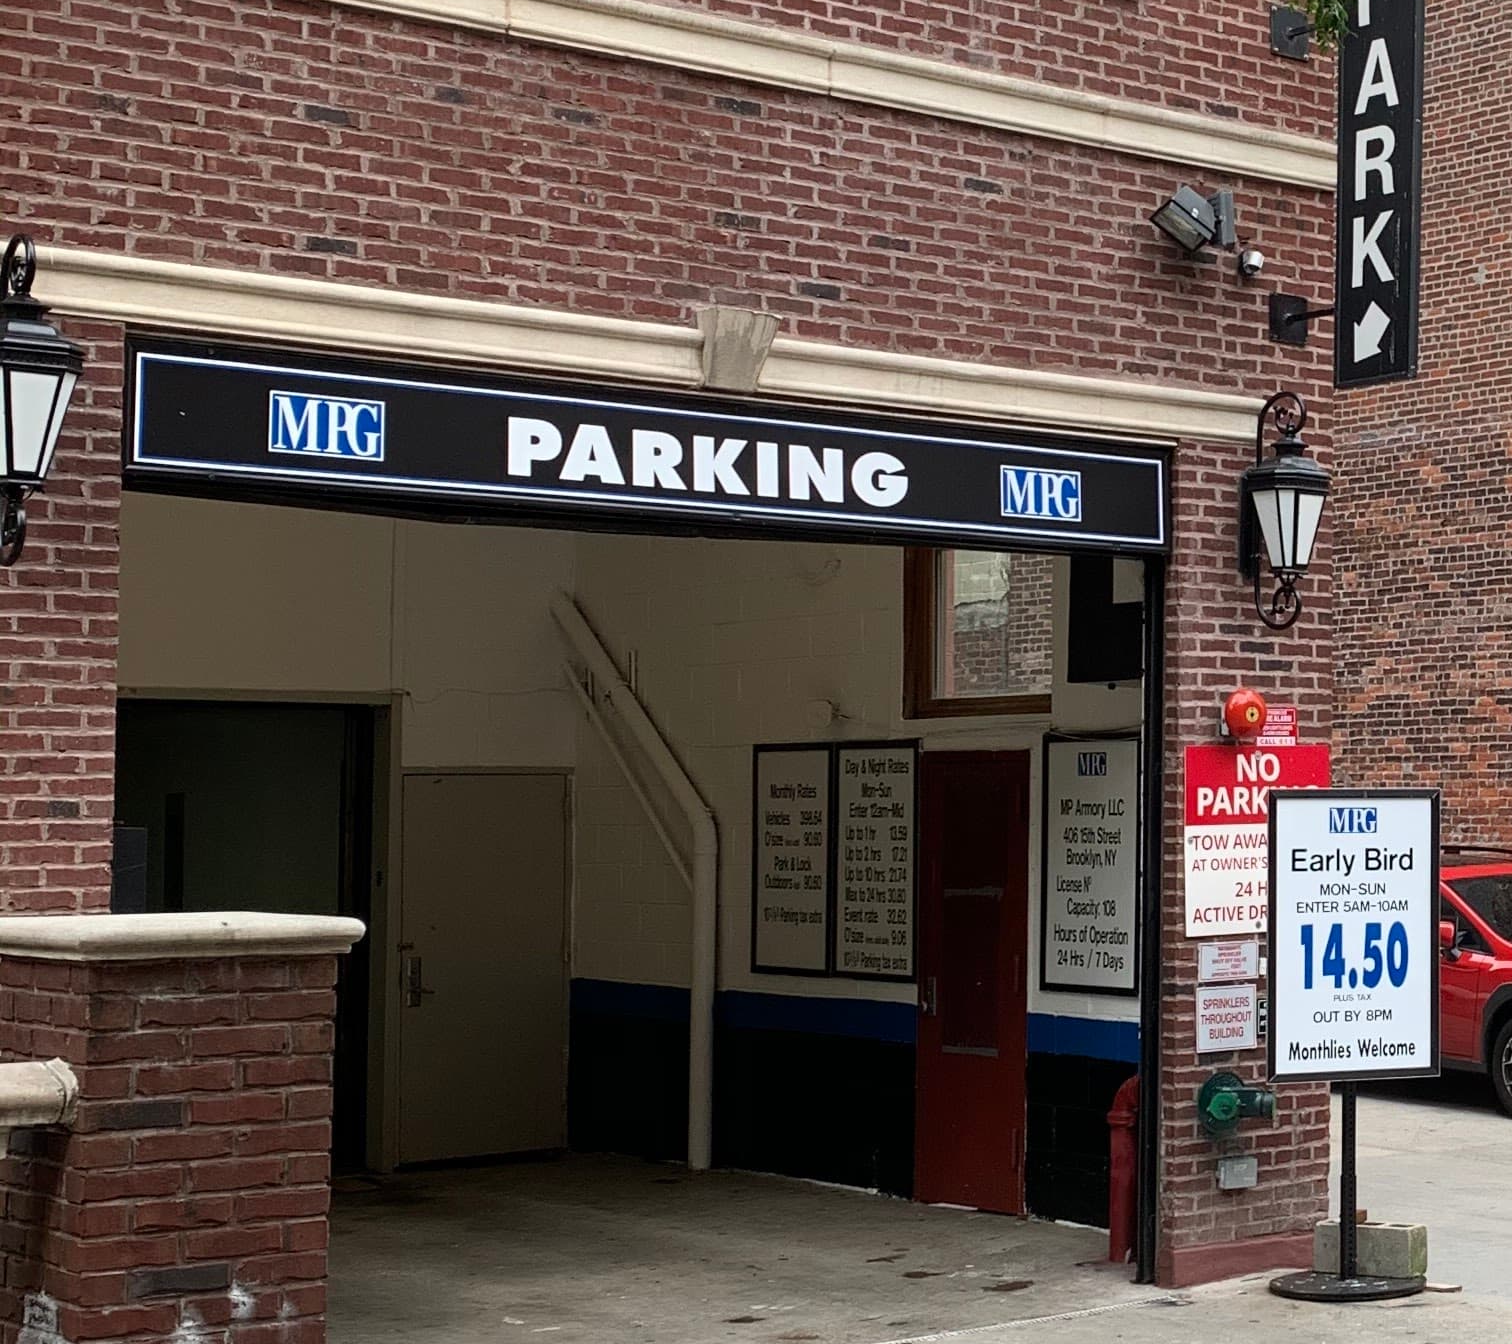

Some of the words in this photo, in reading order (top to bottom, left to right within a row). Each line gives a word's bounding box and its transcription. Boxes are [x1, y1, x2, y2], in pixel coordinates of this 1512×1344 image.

[272, 395, 382, 457] MPG
[507, 415, 910, 508] PARKING
[1003, 469, 1080, 518] MPG
[845, 759, 859, 777] Day
[1236, 753, 1281, 783] NO
[1060, 798, 1073, 816] MP
[1075, 798, 1107, 820] Armory
[1108, 798, 1125, 817] LLC
[1331, 808, 1376, 833] MPG
[1063, 827, 1079, 844] 406
[1097, 826, 1122, 845] Street
[1192, 834, 1229, 851] TOW
[1233, 833, 1268, 850] AWA
[1104, 848, 1118, 866] NY
[1192, 859, 1207, 873] AT
[1210, 856, 1268, 871] OWNER'S
[1291, 847, 1355, 877] Early
[1365, 847, 1413, 871] Bird
[1056, 874, 1083, 894] License
[1235, 881, 1253, 897] 24
[1319, 882, 1386, 896] MON-SUN
[1103, 899, 1117, 917] 108
[1193, 905, 1244, 923] ACTIVE
[1296, 901, 1339, 913] ENTER
[1343, 899, 1408, 912] 5AM-10AM
[1054, 923, 1078, 943] Hours
[1079, 925, 1088, 943] of
[1089, 925, 1129, 948] Operation
[1057, 949, 1068, 967] 24
[1069, 949, 1085, 968] Hrs
[1103, 951, 1124, 974] Days
[1301, 921, 1409, 990] 14.50
[1203, 997, 1250, 1010] SPRINKLERS
[1333, 994, 1354, 1002] PLUS
[1357, 993, 1372, 1001] TAX
[1201, 1011, 1252, 1025] THROUGHOUT
[1313, 1011, 1340, 1023] OUT
[1344, 1010, 1361, 1022] BY
[1366, 1009, 1392, 1022] 8PM
[1209, 1027, 1244, 1039] BUILDING
[1288, 1039, 1351, 1061] Monthlies
[1358, 1036, 1416, 1057] Welcome
